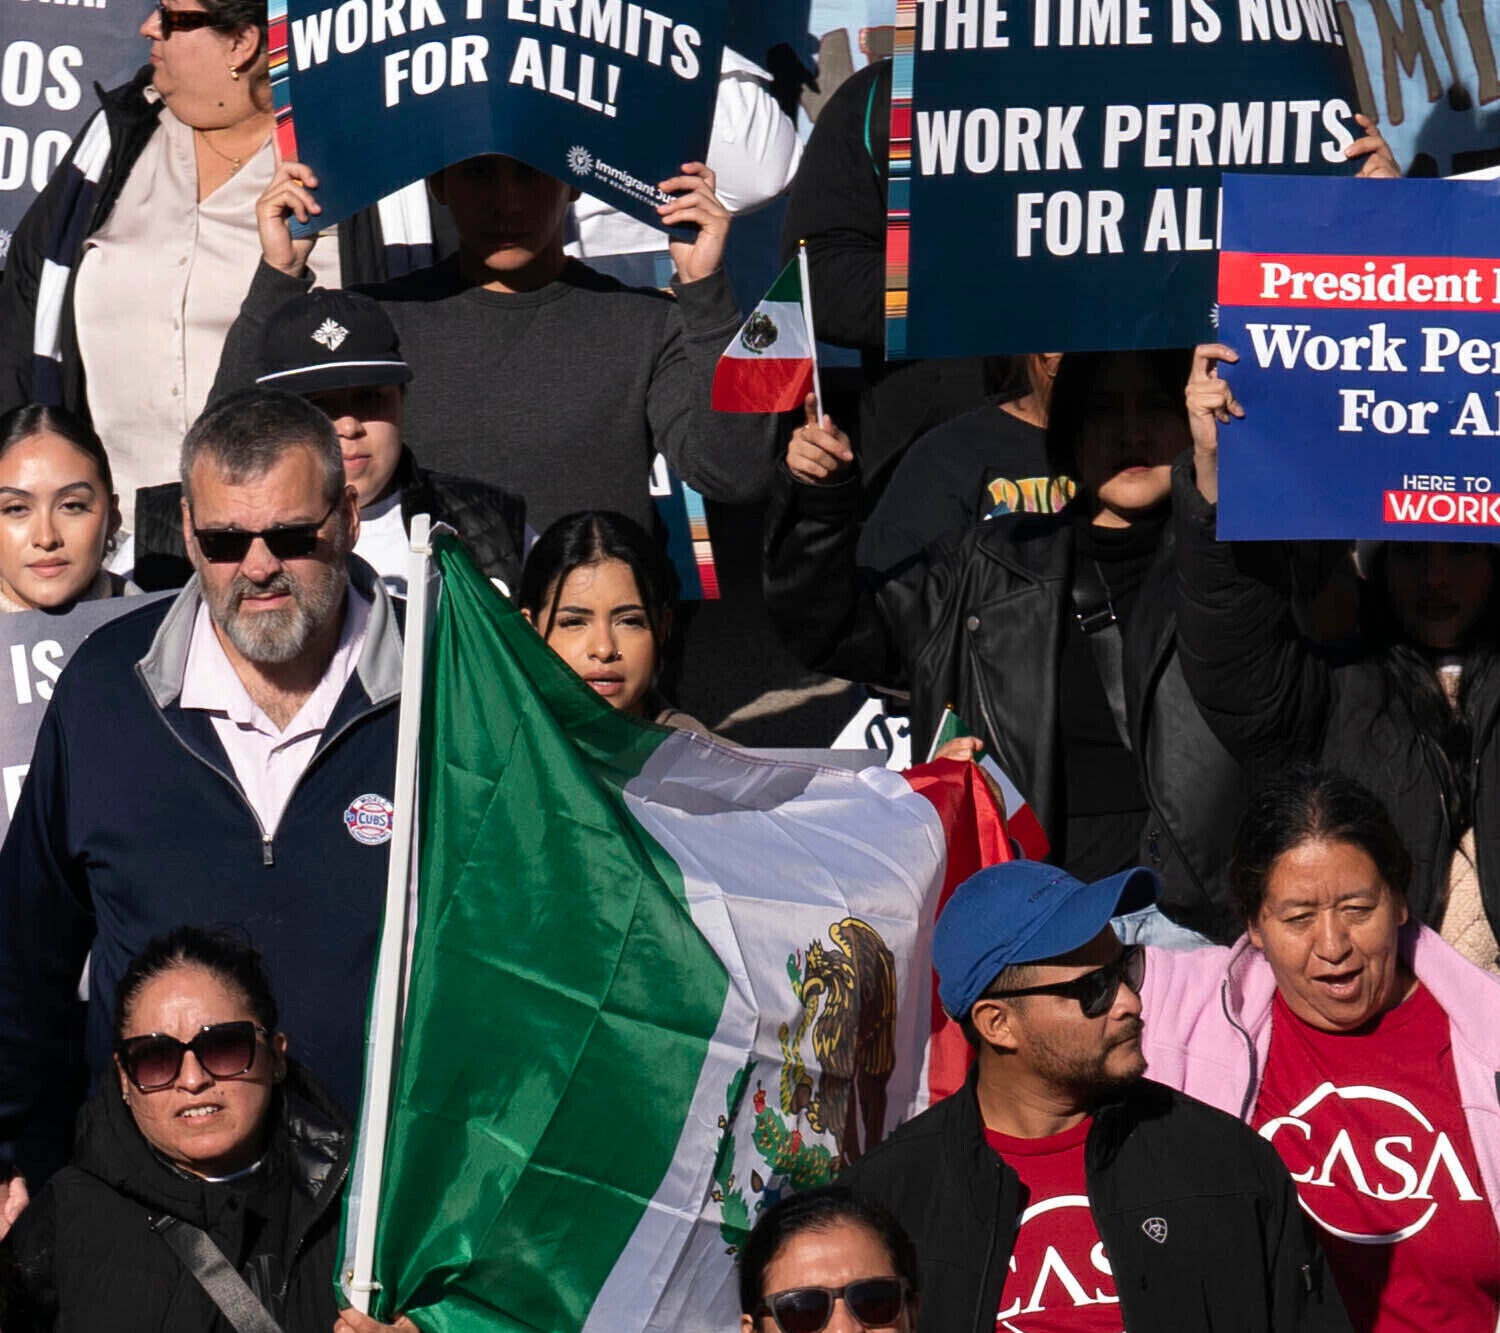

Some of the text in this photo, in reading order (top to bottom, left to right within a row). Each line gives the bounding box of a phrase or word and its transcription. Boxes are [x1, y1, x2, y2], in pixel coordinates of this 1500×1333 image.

[919, 0, 1010, 51] THE
[1033, 0, 1153, 46] TIME
[385, 34, 622, 118] FOR ALL!
[916, 98, 1356, 177] WORK PERMITS
[595, 158, 656, 197] Immigrant
[1016, 191, 1125, 258] FOR
[1260, 261, 1484, 307] President
[1247, 323, 1410, 376] Work
[1340, 389, 1446, 438] For
[1401, 473, 1494, 495] HERE TO
[12, 639, 66, 708] IS
[358, 812, 387, 827] CUBS
[1259, 1111, 1482, 1203] CASA
